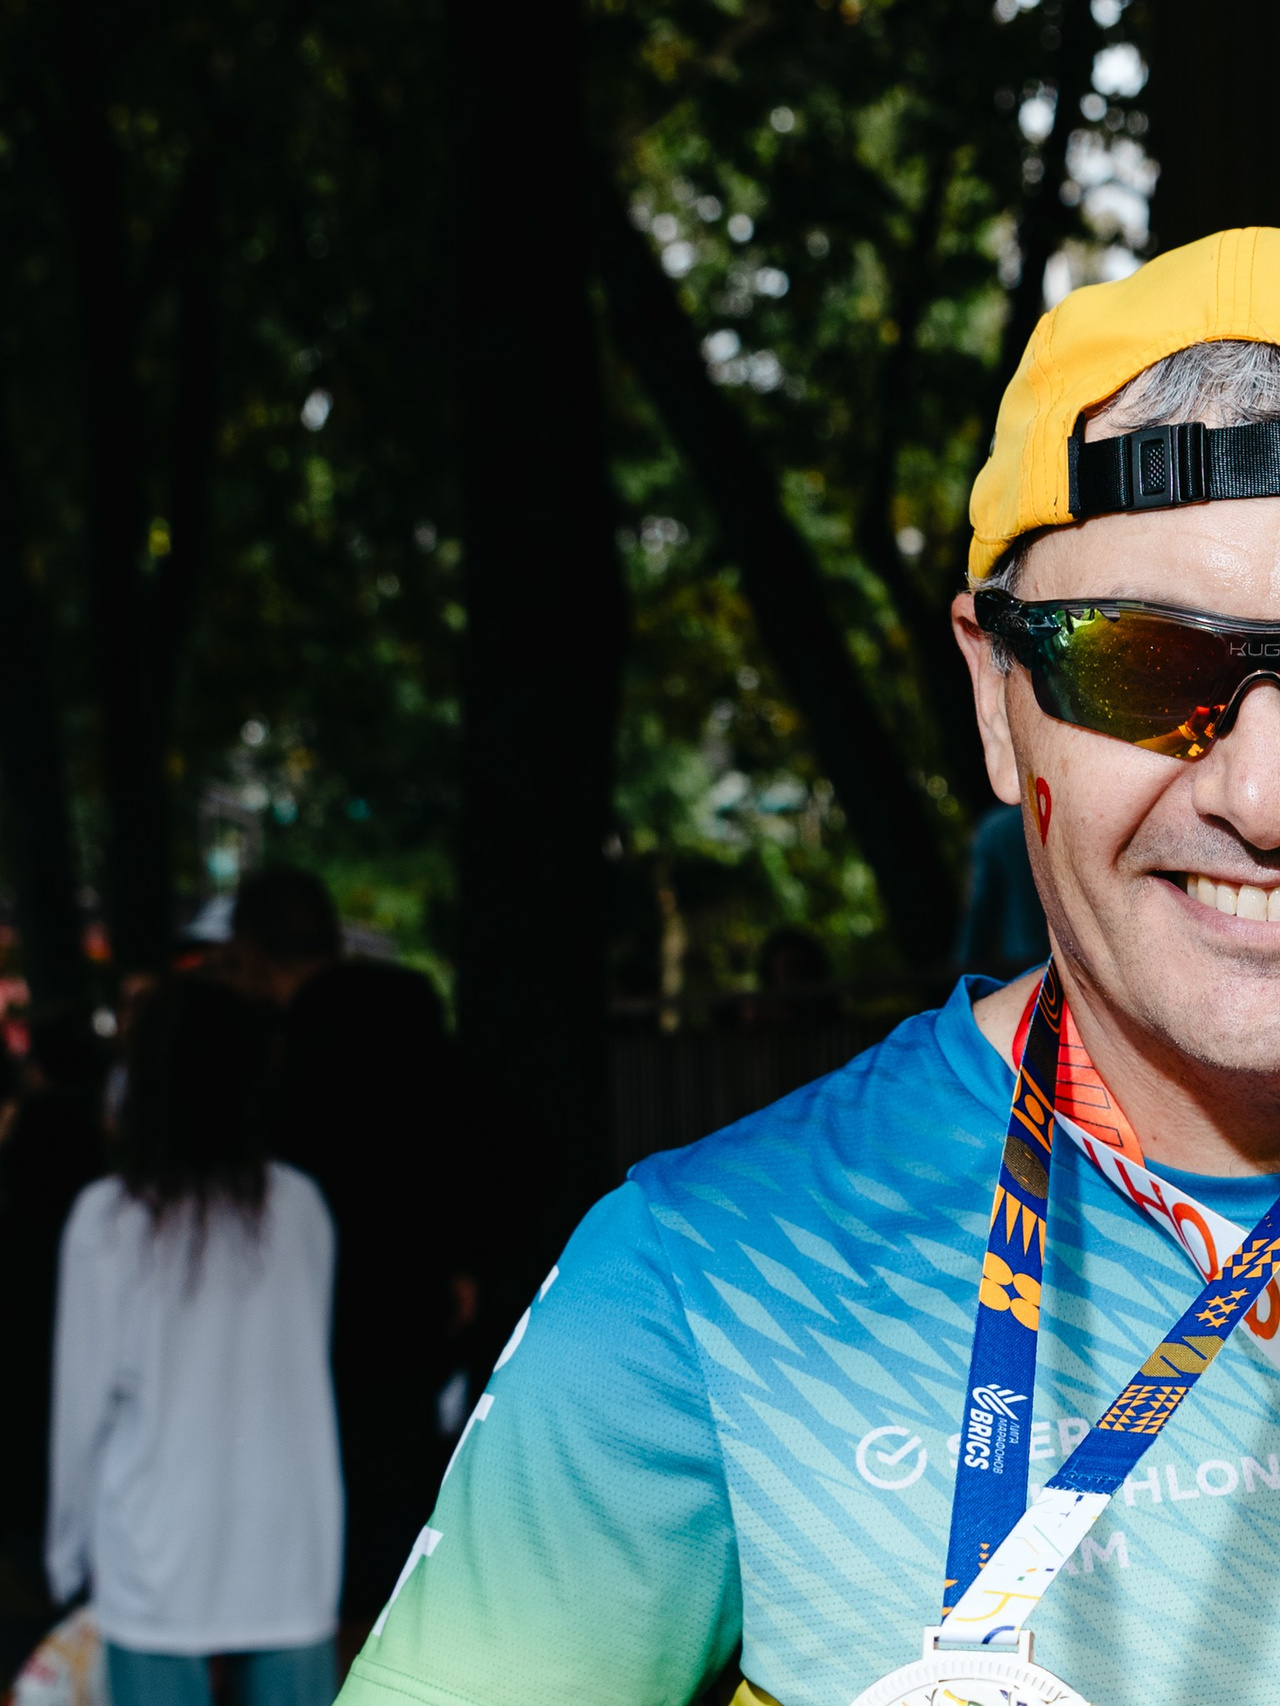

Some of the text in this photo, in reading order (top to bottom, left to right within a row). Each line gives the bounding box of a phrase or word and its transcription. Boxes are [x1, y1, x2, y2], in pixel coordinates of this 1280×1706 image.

[964, 1408, 993, 1470] BRICS
[993, 1417, 1007, 1474] МАРАФОНОВ
[1009, 1421, 1020, 1444] ЛИГА
